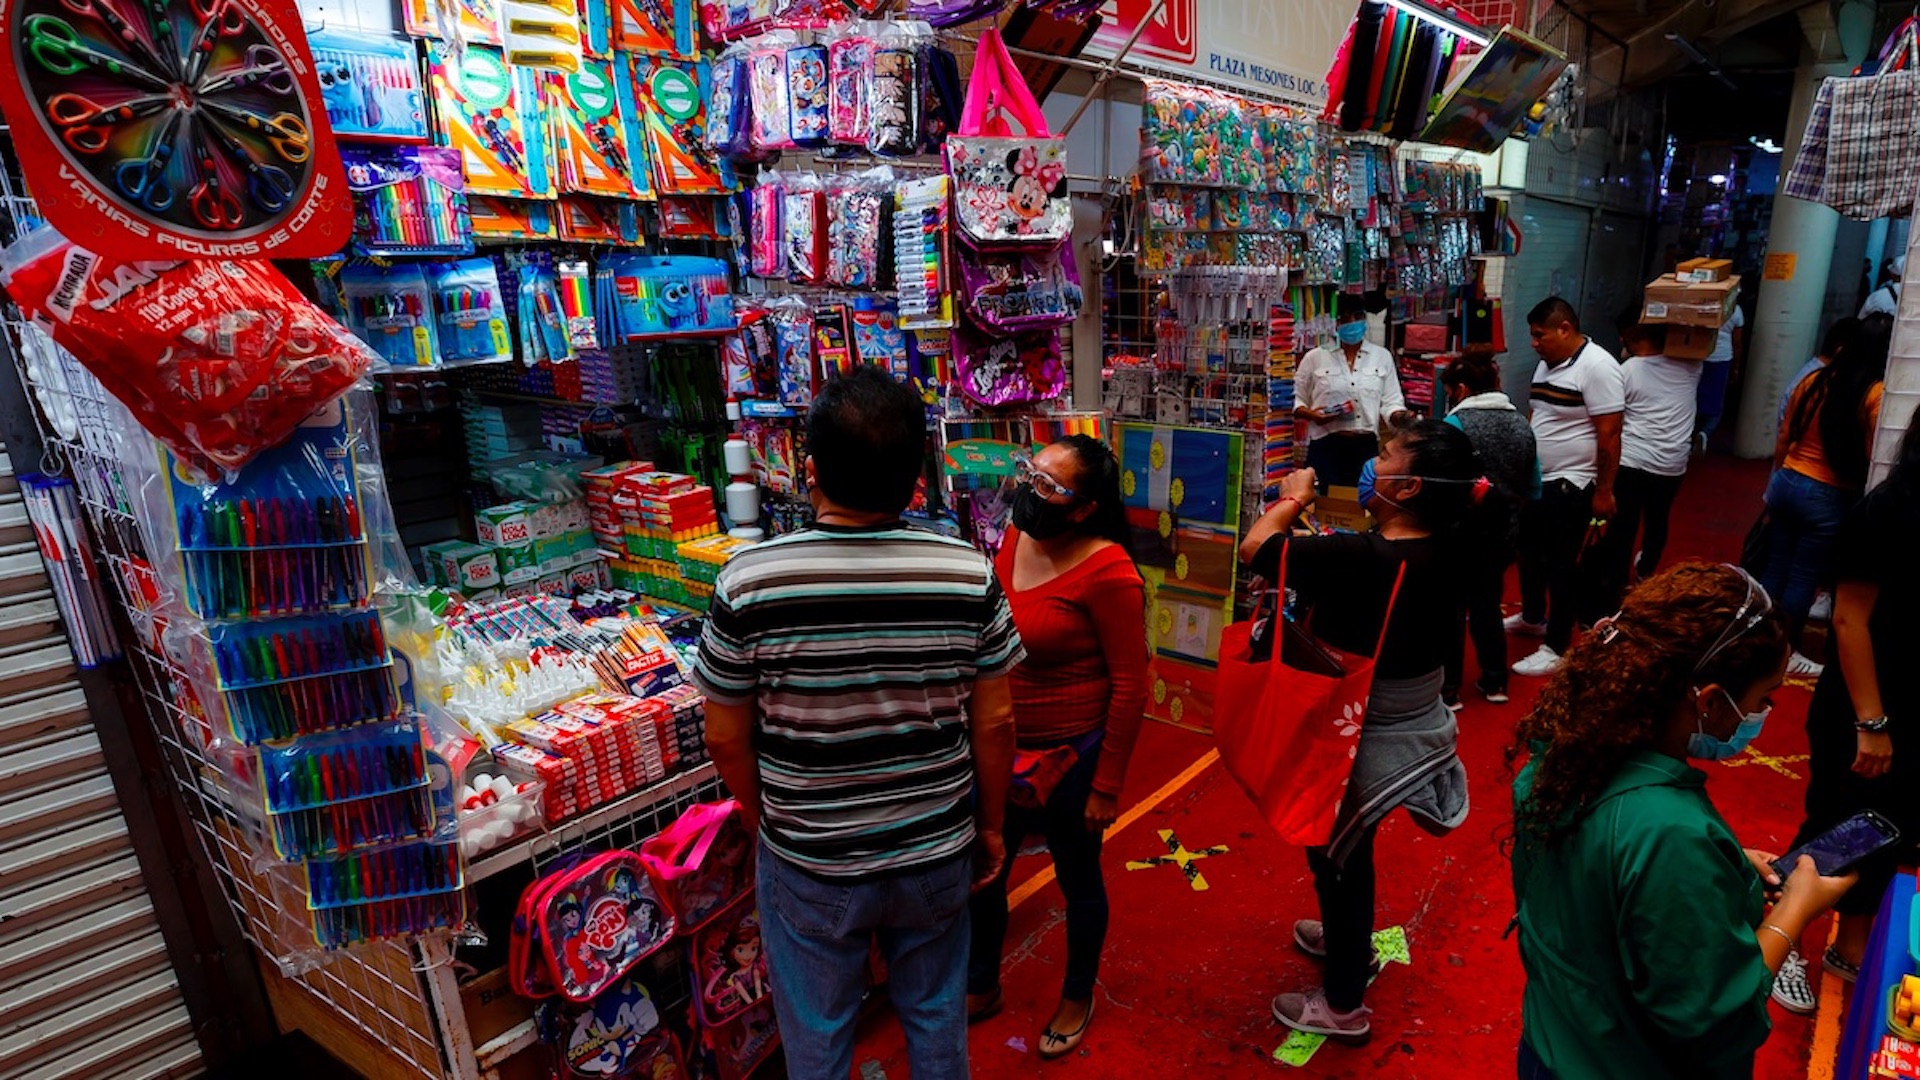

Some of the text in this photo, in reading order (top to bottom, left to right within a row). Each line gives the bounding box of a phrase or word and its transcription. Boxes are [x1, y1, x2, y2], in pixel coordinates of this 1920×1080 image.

[1210, 52, 1247, 78] PLAZA
[1250, 64, 1295, 90] MESONES
[1298, 77, 1317, 96] LOC
[58, 163, 151, 237] VARIAS
[157, 232, 260, 257] FIGURAS
[289, 172, 328, 233] CORTE
[138, 302, 167, 323] 119
[154, 319, 174, 332] 12
[501, 523, 528, 534] KOLA
[502, 531, 528, 542] LOKA
[567, 1036, 606, 1061] SONIC
